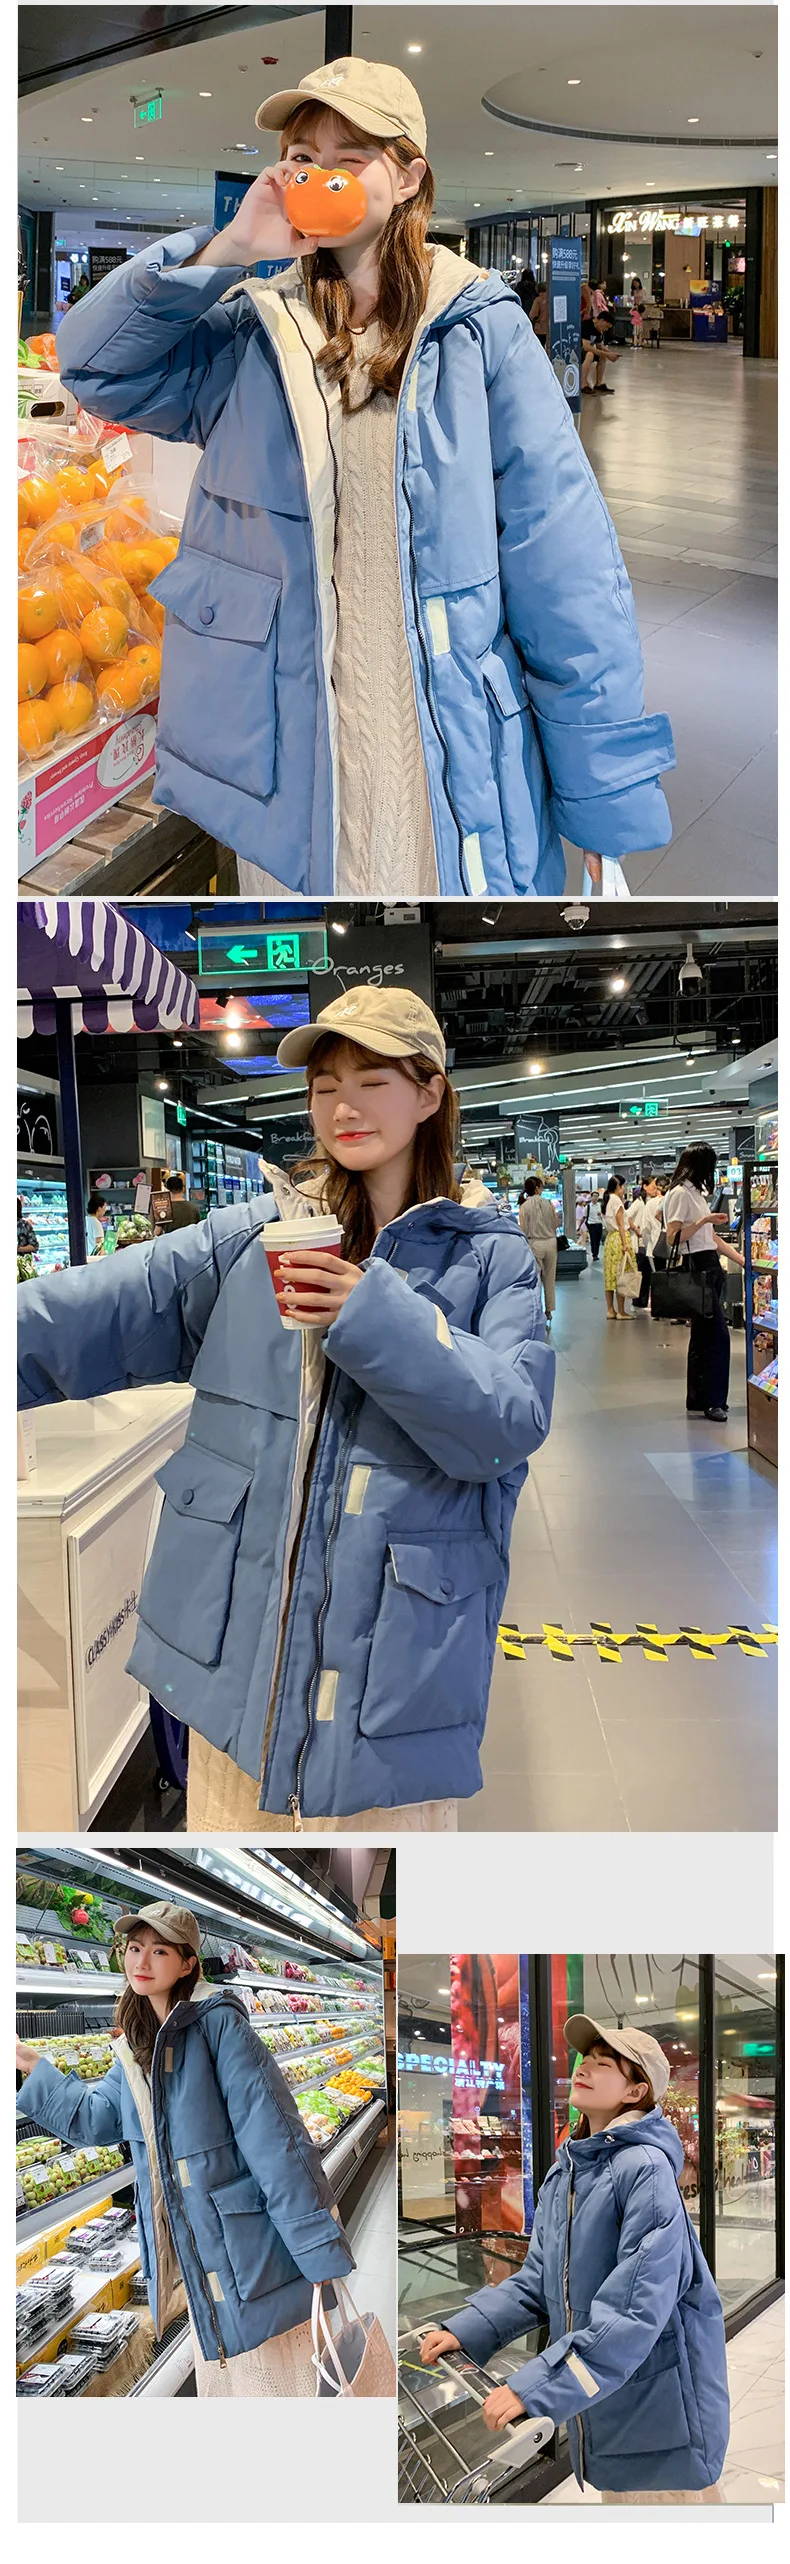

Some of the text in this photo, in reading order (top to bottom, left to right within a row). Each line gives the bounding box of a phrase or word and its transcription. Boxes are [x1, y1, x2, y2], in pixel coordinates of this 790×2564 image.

[638, 209, 680, 231] WANG
[311, 956, 405, 987] Oranges
[270, 1132, 317, 1144] Breakfa
[730, 1167, 742, 1176] 03
[398, 2051, 506, 2079] SPECIALTY
